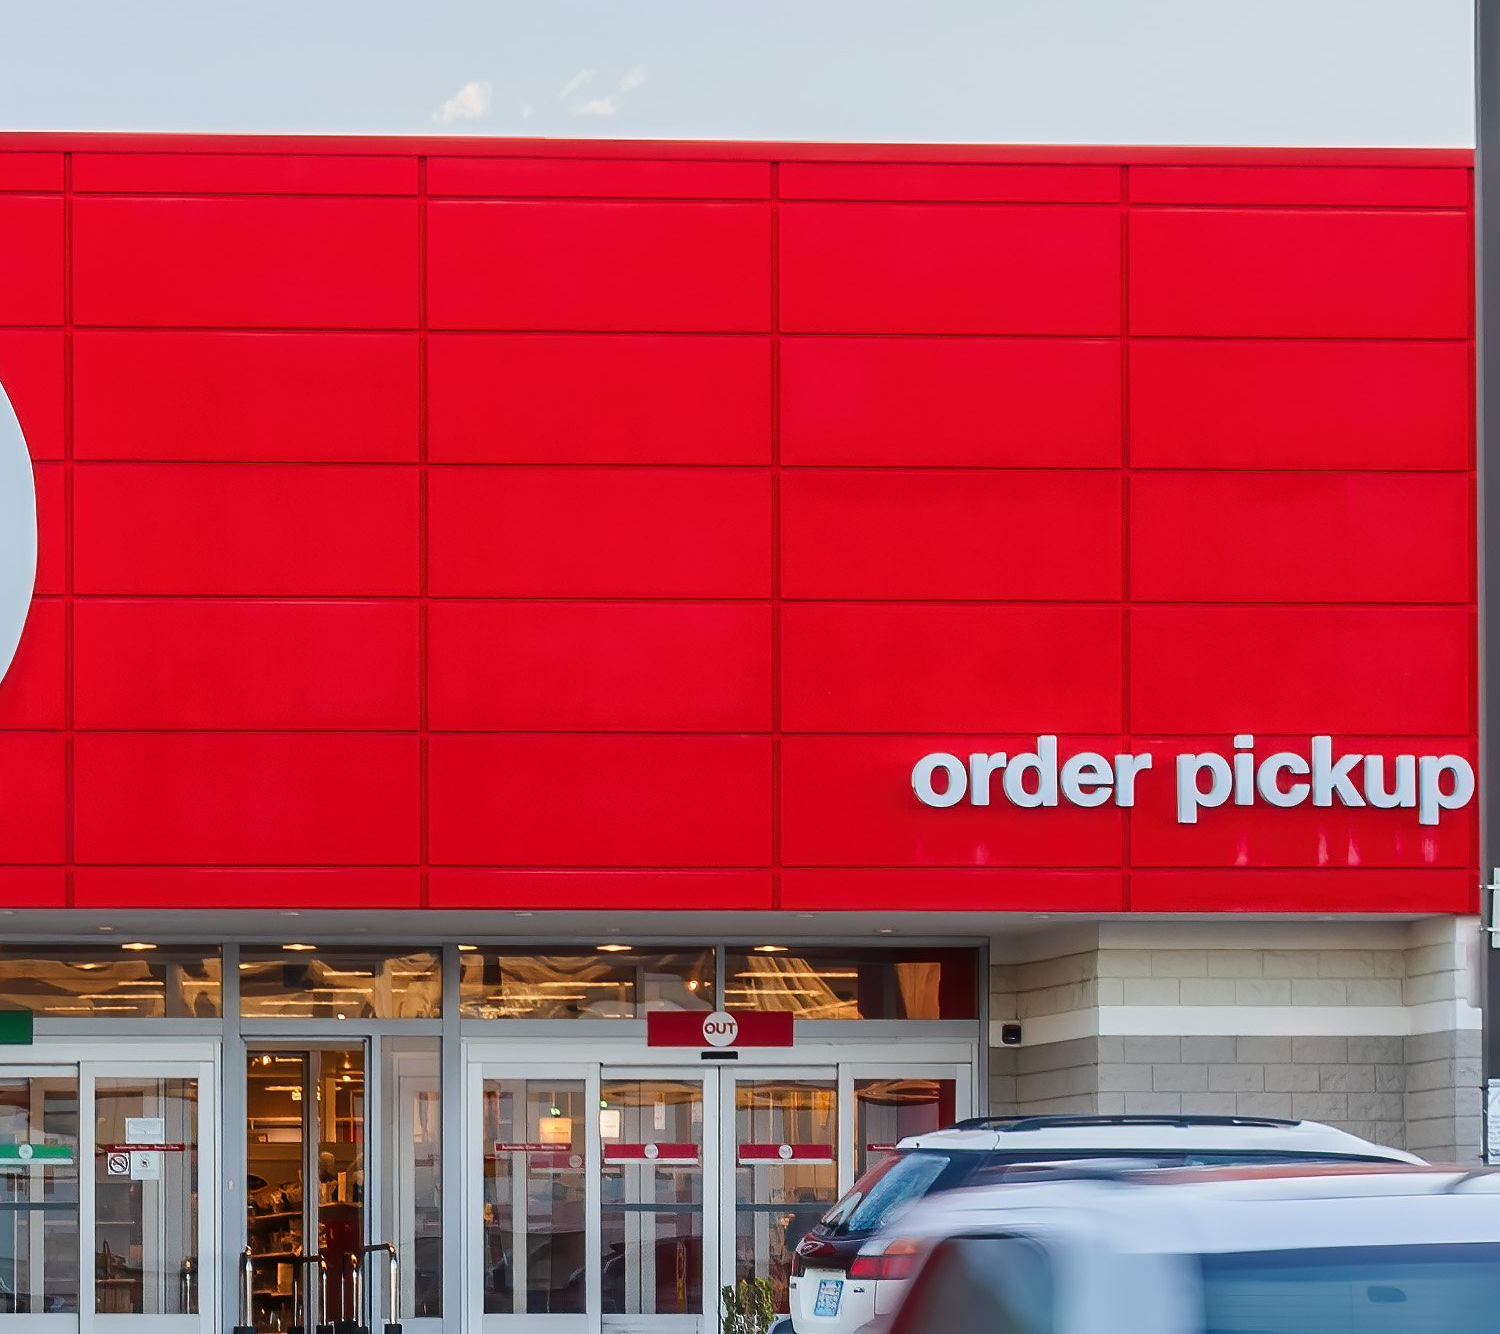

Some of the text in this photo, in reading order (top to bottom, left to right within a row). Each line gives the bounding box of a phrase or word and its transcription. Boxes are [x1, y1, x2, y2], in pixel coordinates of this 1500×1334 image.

[911, 734, 1475, 825] order pickup
[704, 1022, 736, 1035] OUT
